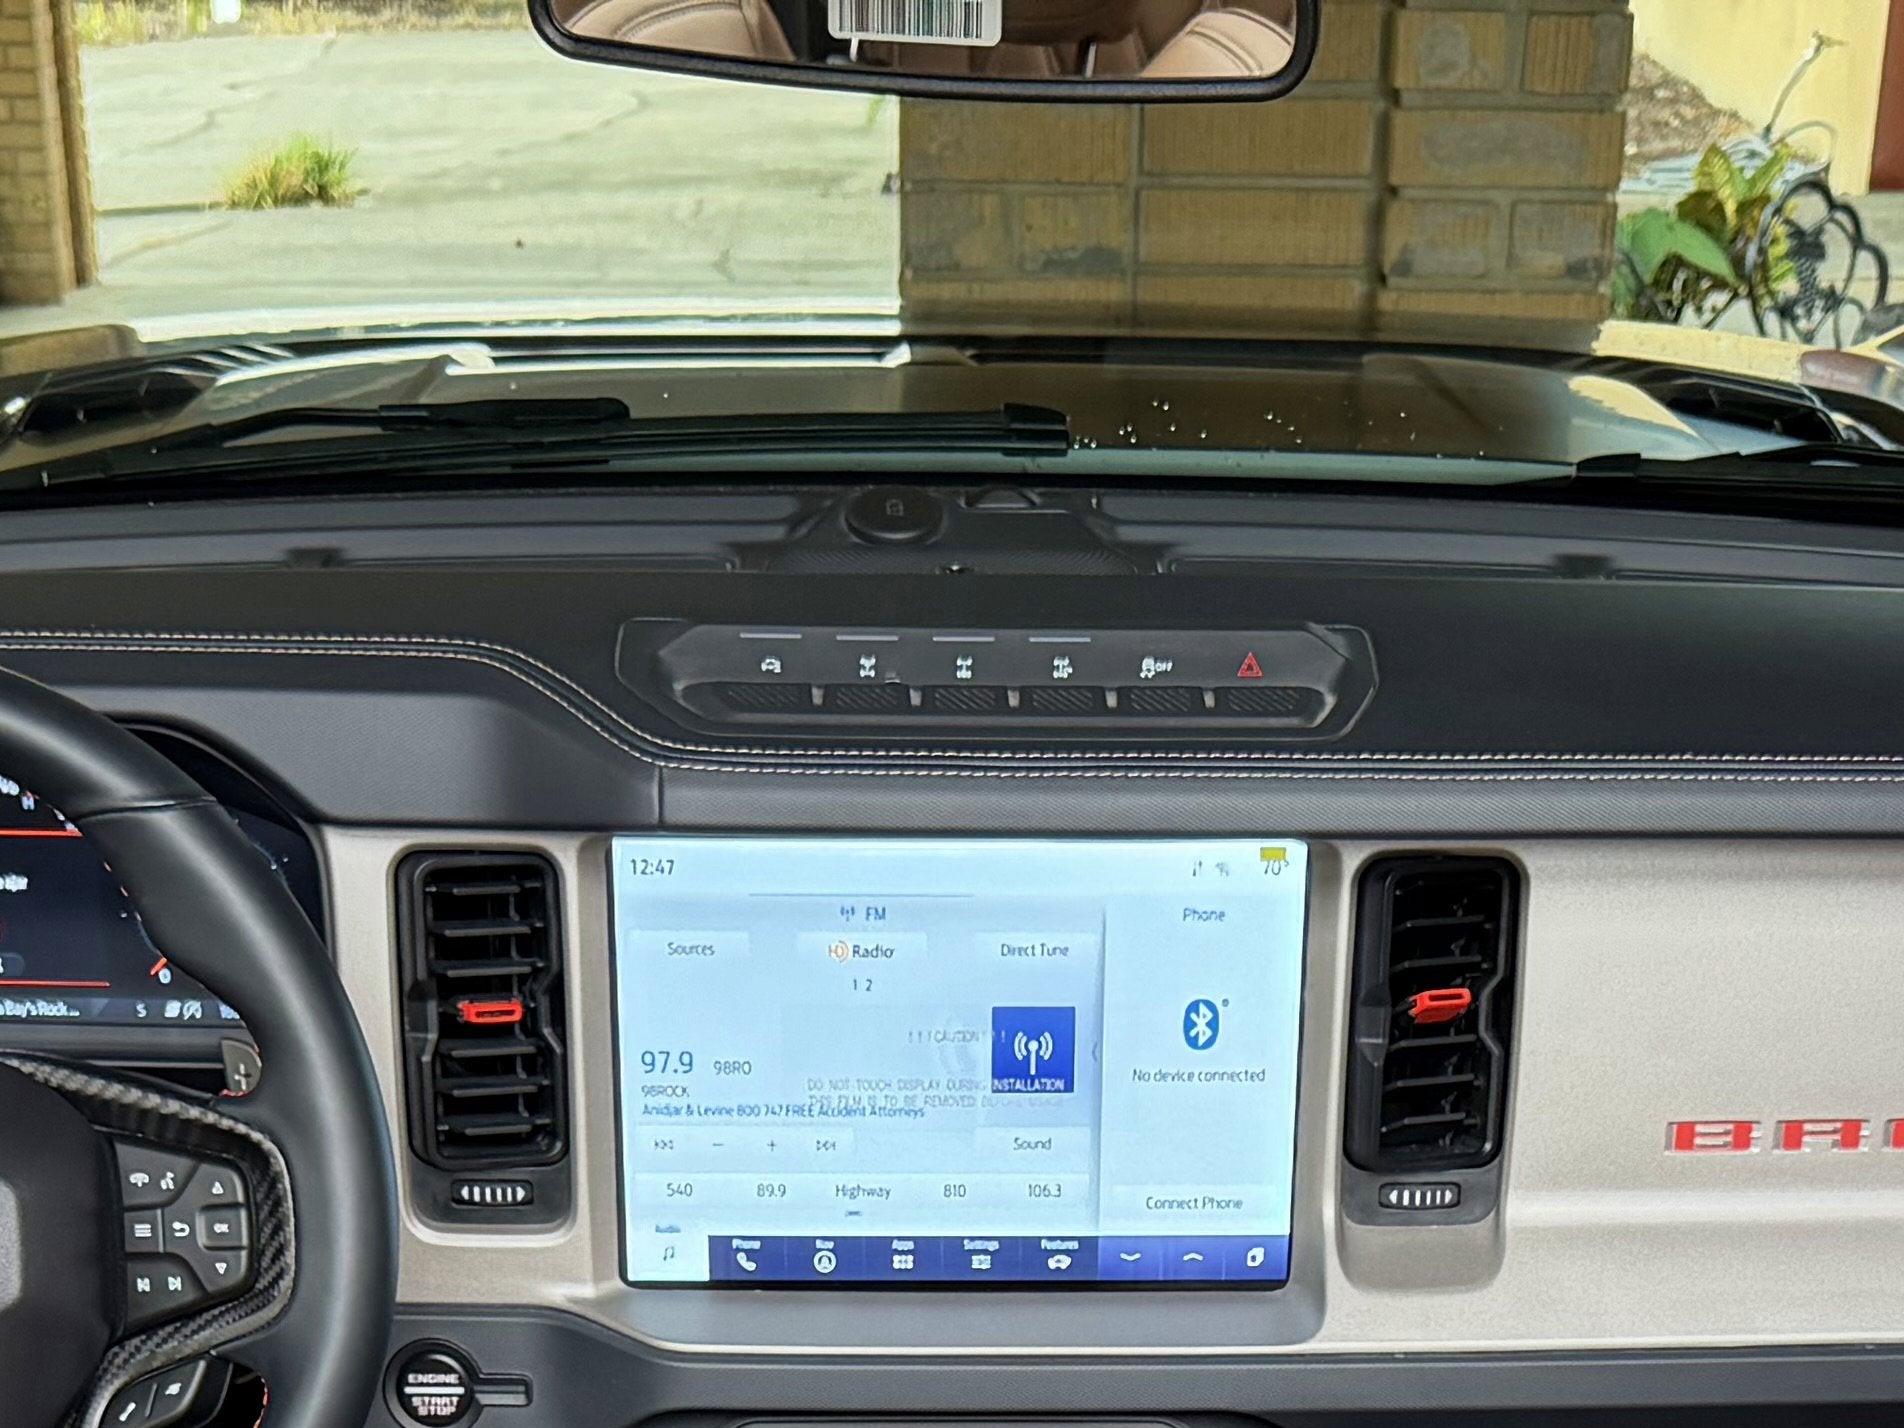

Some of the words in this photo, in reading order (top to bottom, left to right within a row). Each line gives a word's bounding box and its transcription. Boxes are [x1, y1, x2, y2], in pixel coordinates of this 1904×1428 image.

[630, 858, 675, 876] 12:47
[865, 906, 887, 922] FM
[1182, 907, 1226, 923] Phone
[667, 941, 715, 956] Sources
[852, 943, 895, 959] Radio
[1000, 943, 1036, 957] Direct
[1039, 943, 1069, 957] Tune
[641, 1050, 694, 1074] 97.9
[1132, 1068, 1152, 1082] No
[1153, 1068, 1195, 1082] device
[1197, 1068, 1266, 1083] connected
[1013, 1136, 1052, 1151] Sound
[667, 1183, 693, 1197] 540
[756, 1183, 787, 1197] 89.9
[835, 1183, 892, 1200] Highway
[943, 1184, 966, 1198] 810
[1028, 1184, 1062, 1198] 106.3
[1146, 1196, 1198, 1210] Connect
[1202, 1196, 1243, 1210] Phone
[407, 1373, 460, 1385] ENGINE
[411, 1396, 459, 1407] START
[417, 1406, 457, 1417] STOP
